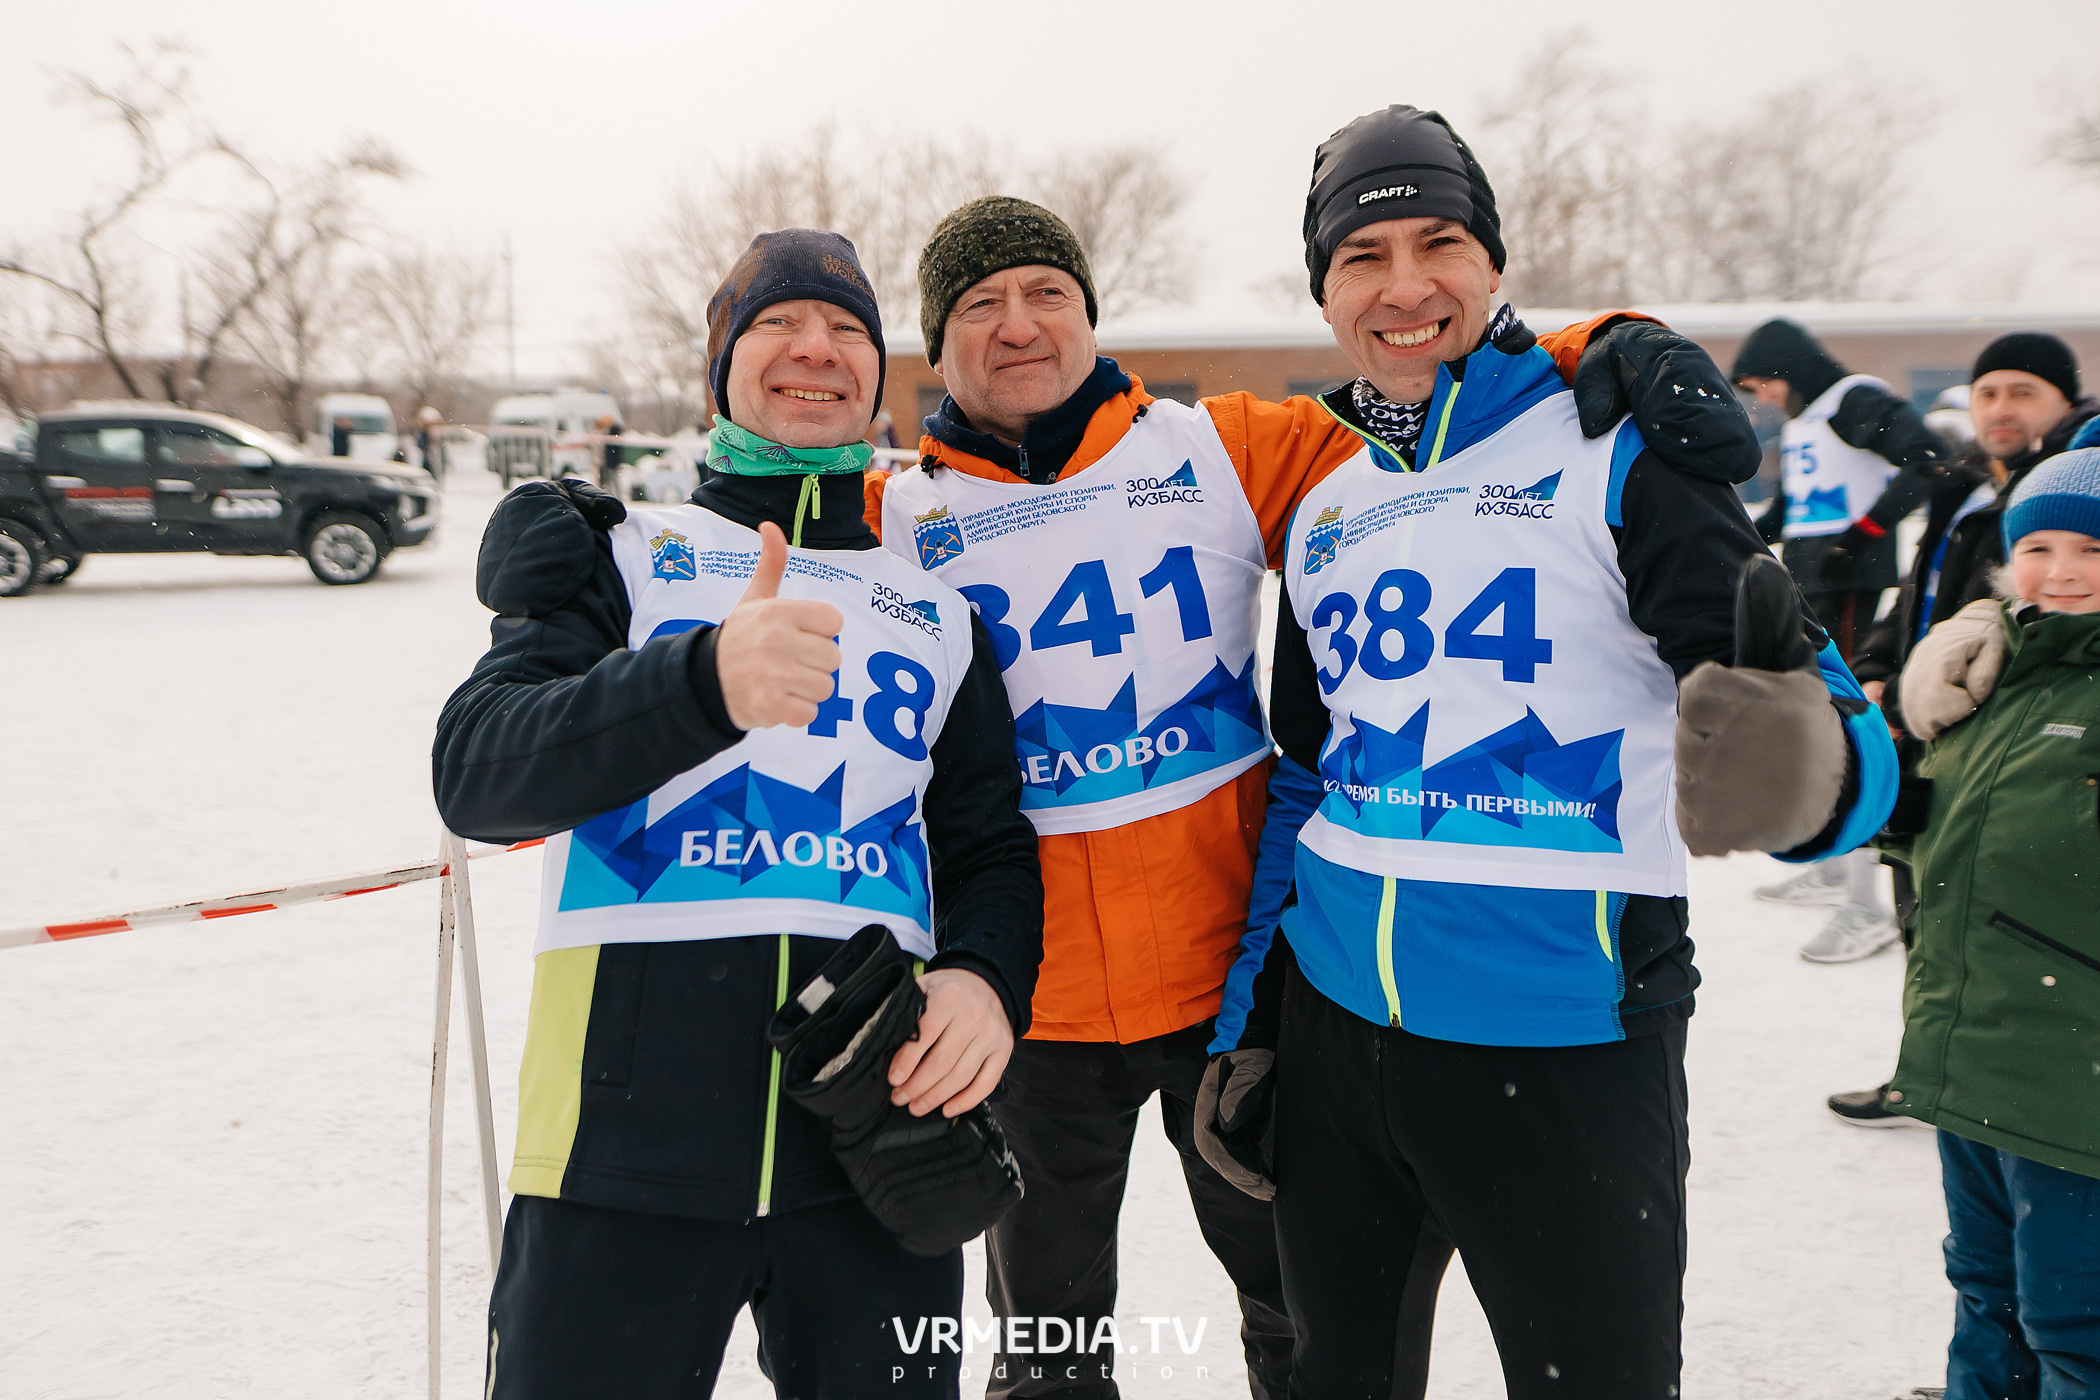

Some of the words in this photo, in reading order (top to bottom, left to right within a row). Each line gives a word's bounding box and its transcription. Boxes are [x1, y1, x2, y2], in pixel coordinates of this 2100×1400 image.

[1359, 186, 1404, 204] CRAFT
[822, 253, 859, 277] Jack
[1126, 477, 1159, 493] 300
[1163, 479, 1184, 488] ЛЕТ
[1426, 486, 1471, 498] ПОЛИТИКИ,
[1479, 485, 1515, 499] 300
[1517, 491, 1542, 500] ЛЕТ
[960, 505, 1006, 524] УПРАВЛЕНИЕ
[1007, 490, 1068, 510] МОЛОДЕЖНОЙ
[1070, 483, 1116, 498] ПОЛИТИКИ,
[1127, 490, 1204, 508] КУЗБАСС
[1418, 496, 1448, 507] СПОРТА
[1475, 502, 1555, 519] КУЗБАСС
[963, 510, 1014, 531] ФИЗИЧЕСКОЙ
[1015, 501, 1054, 516] КУЛЬТУРЫ
[1065, 494, 1098, 505] СПОРТА
[966, 514, 1031, 539] АДМИНИСТРАЦИИ
[1032, 503, 1086, 519] БЕЛОВСКОГО
[1389, 505, 1435, 521] БЕЛОВСКОГО
[968, 526, 1016, 546] ГОРОДСКОГО
[1017, 518, 1046, 531] ОКРУГА
[813, 566, 845, 582] СПОРТА
[873, 583, 904, 606] 300
[871, 596, 943, 641] КУЗБАСС
[1312, 567, 1553, 695] 384
[1386, 787, 1458, 809] БЫТЬ
[1466, 793, 1597, 819] ПЕРВЫМИ!
[680, 829, 888, 878] БЕЛОВО
